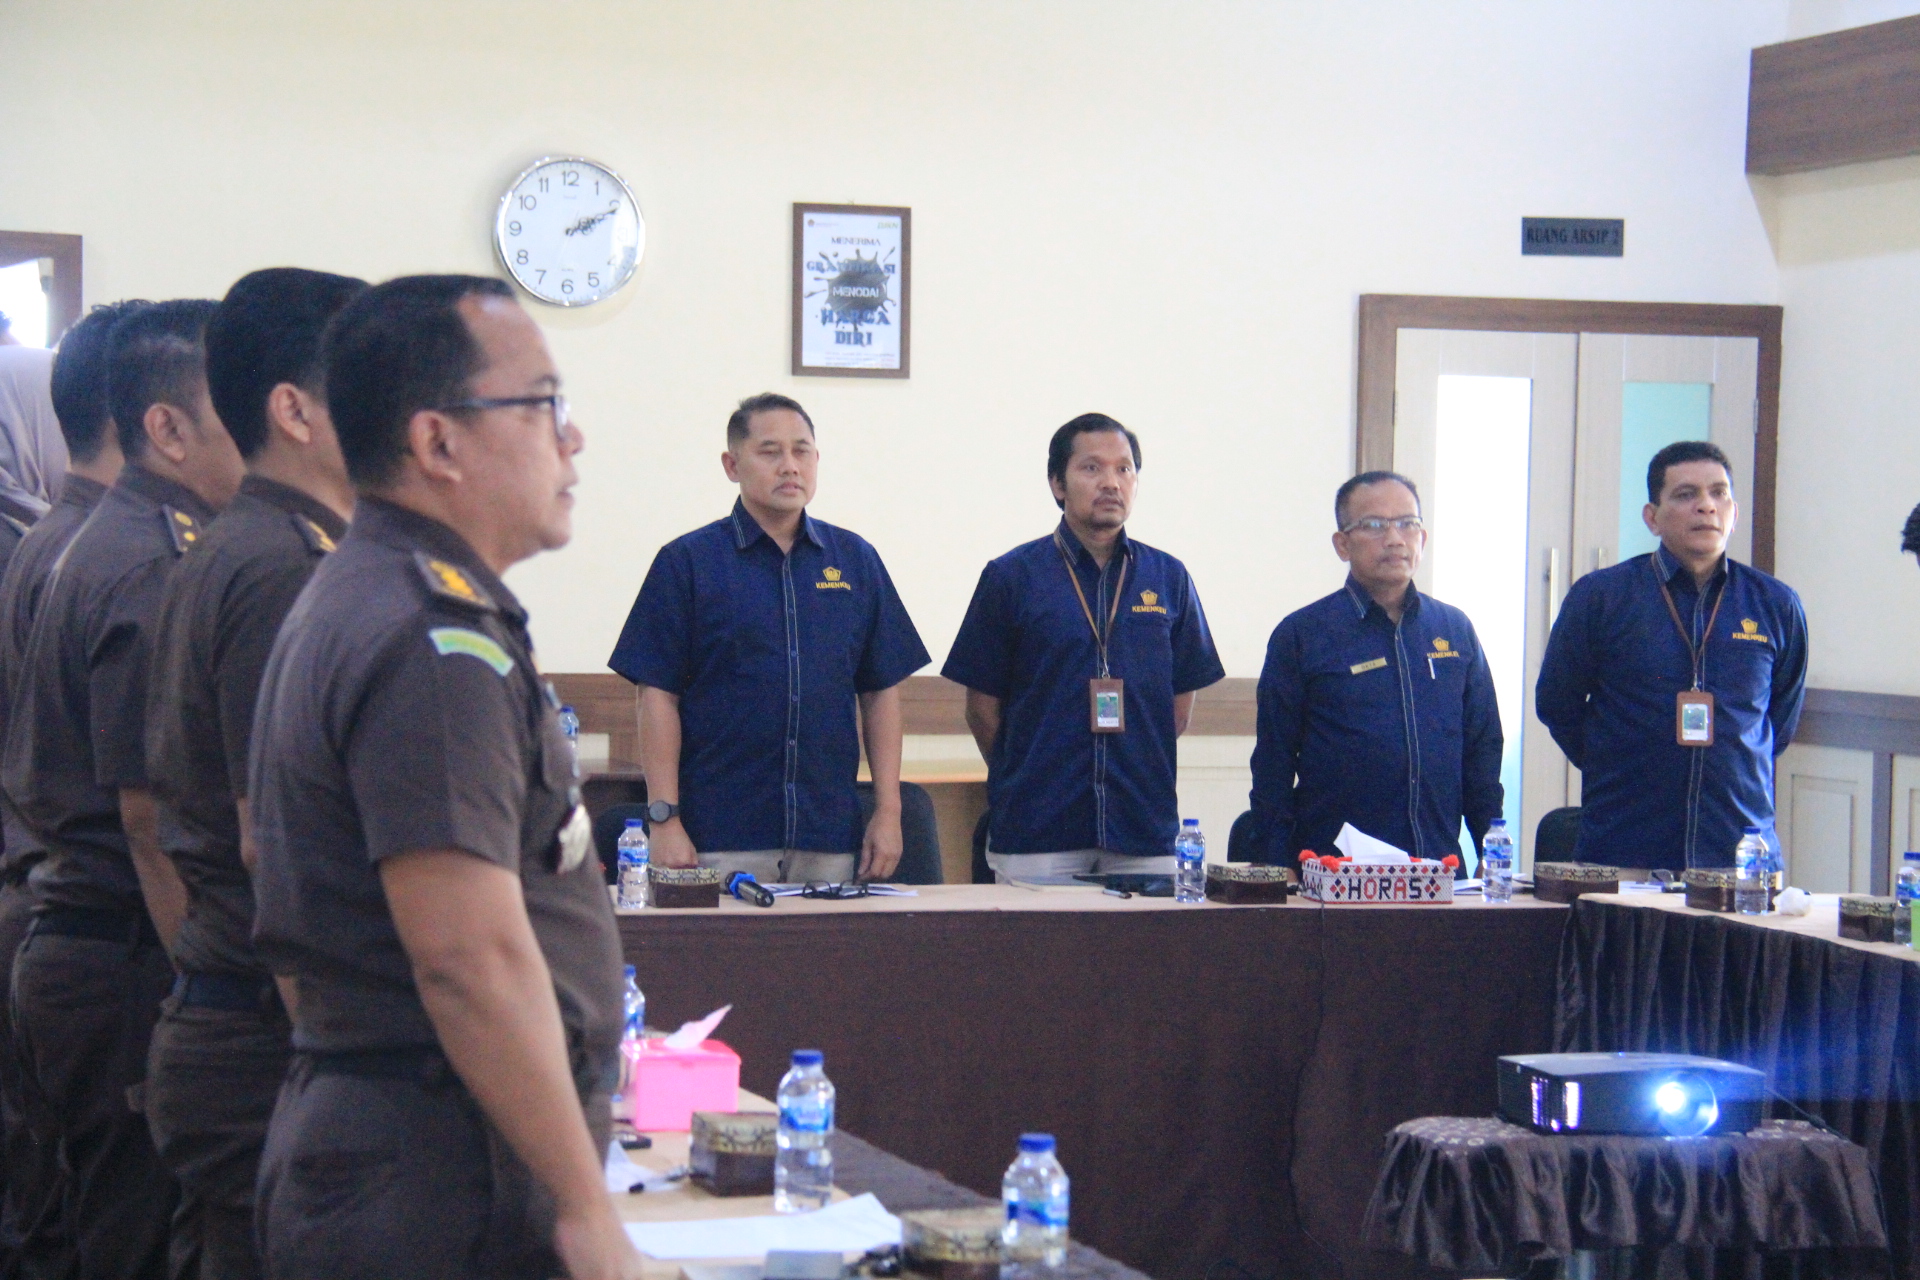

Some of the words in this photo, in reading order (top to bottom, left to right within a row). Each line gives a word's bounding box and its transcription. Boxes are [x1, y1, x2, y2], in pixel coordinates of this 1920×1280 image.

[538, 177, 549, 193] 11
[562, 170, 579, 187] 12
[594, 180, 599, 196] 1
[519, 194, 537, 211] 10
[509, 220, 522, 237] 9
[1526, 228, 1568, 243] RUANG
[1572, 228, 1609, 244] ARSIP
[831, 236, 881, 247] MENERIMA
[516, 249, 529, 265] 8
[535, 269, 547, 285] 7
[588, 272, 600, 288] 5
[561, 278, 574, 294] 6
[833, 286, 880, 298] MENODAI
[835, 330, 873, 346] DIRI
[1349, 877, 1422, 900] HORAS
